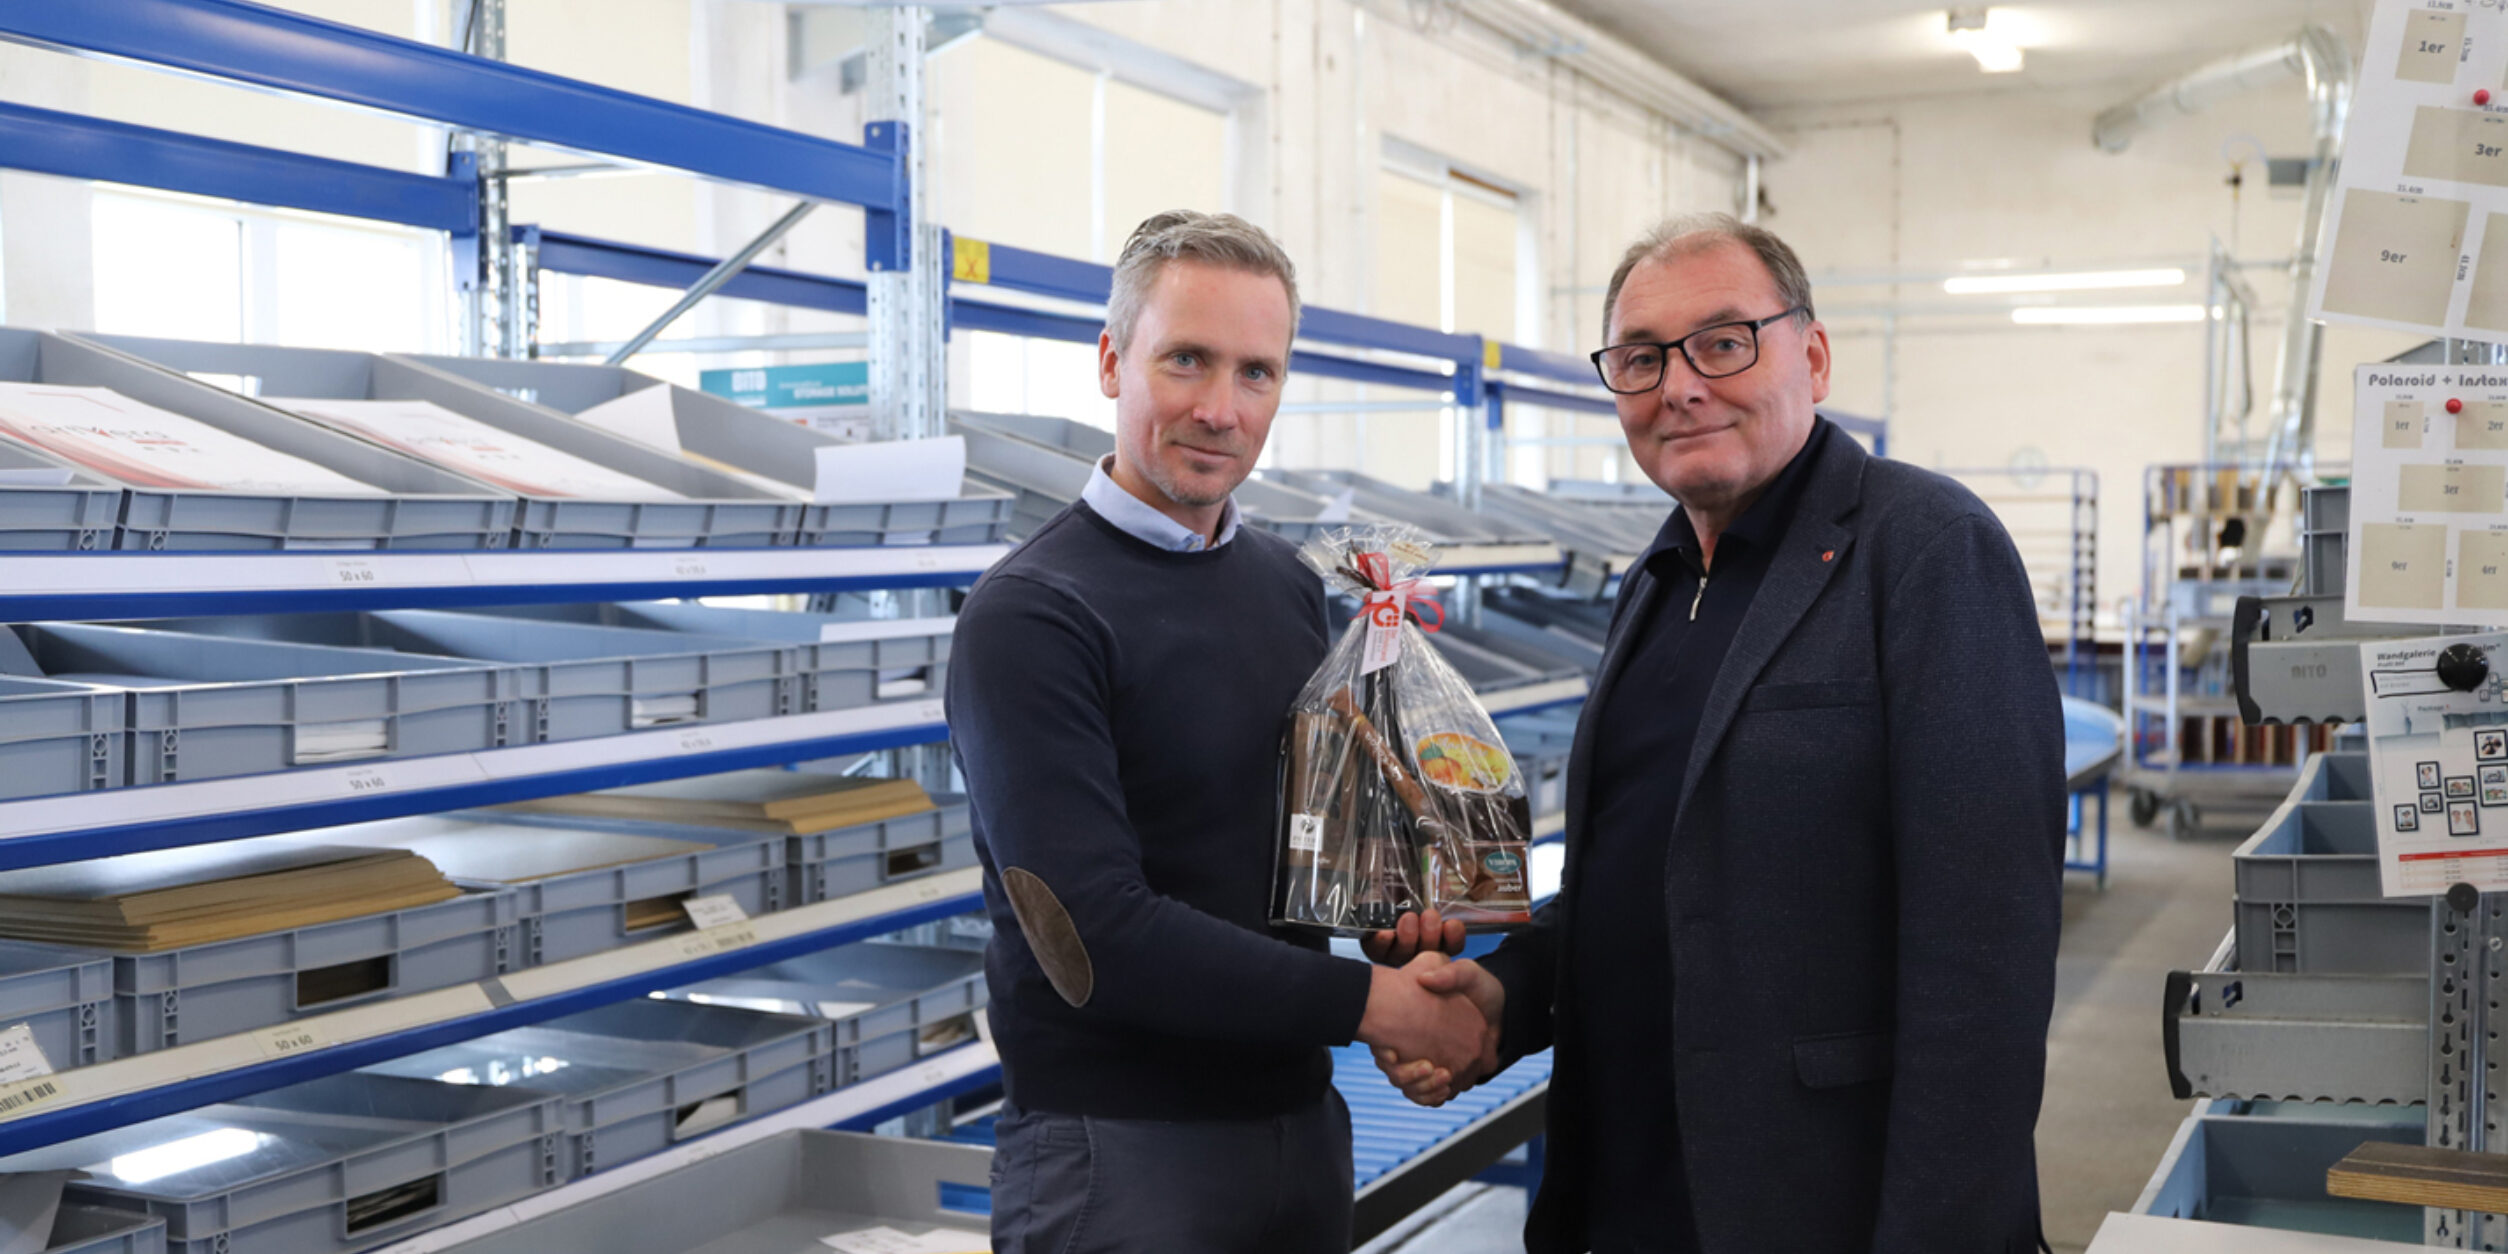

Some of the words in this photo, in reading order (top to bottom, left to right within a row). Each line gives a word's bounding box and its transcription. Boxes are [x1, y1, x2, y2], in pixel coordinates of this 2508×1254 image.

[2418, 39, 2446, 54] 1er
[2474, 142, 2503, 157] 3er
[2380, 248, 2408, 264] 9er
[2368, 373, 2436, 387] Polaroid
[339, 570, 353, 582] 50
[361, 570, 374, 581] 60
[2377, 648, 2436, 662] Wandgalerie
[349, 779, 364, 789] 50
[371, 777, 385, 787] 60
[275, 1038, 290, 1051] 50
[298, 1034, 313, 1046] 60
